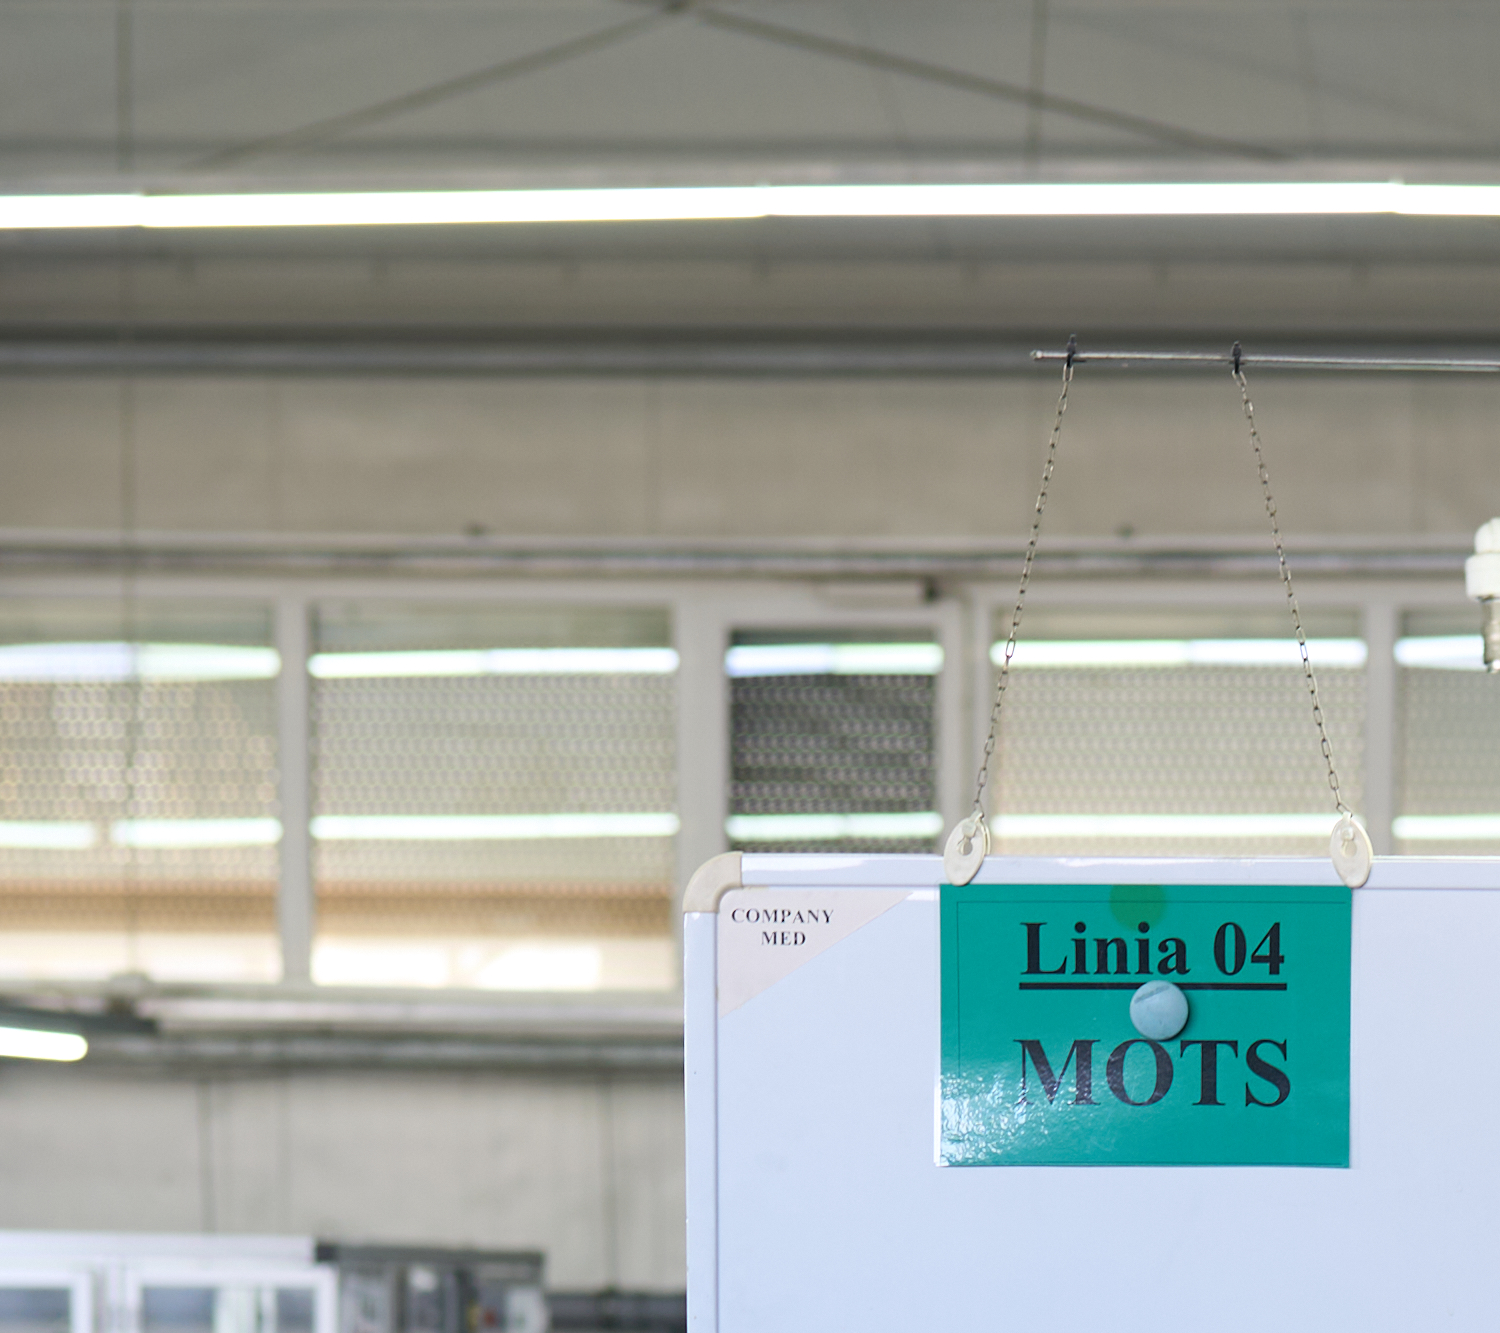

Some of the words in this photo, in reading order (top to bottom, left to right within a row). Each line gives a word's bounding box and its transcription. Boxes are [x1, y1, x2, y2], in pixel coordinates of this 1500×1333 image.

[731, 908, 834, 924] COMPANY
[761, 931, 806, 946] MED
[1020, 921, 1191, 976] Linia
[1213, 921, 1285, 976] 04
[1013, 1038, 1291, 1107] MOTS
